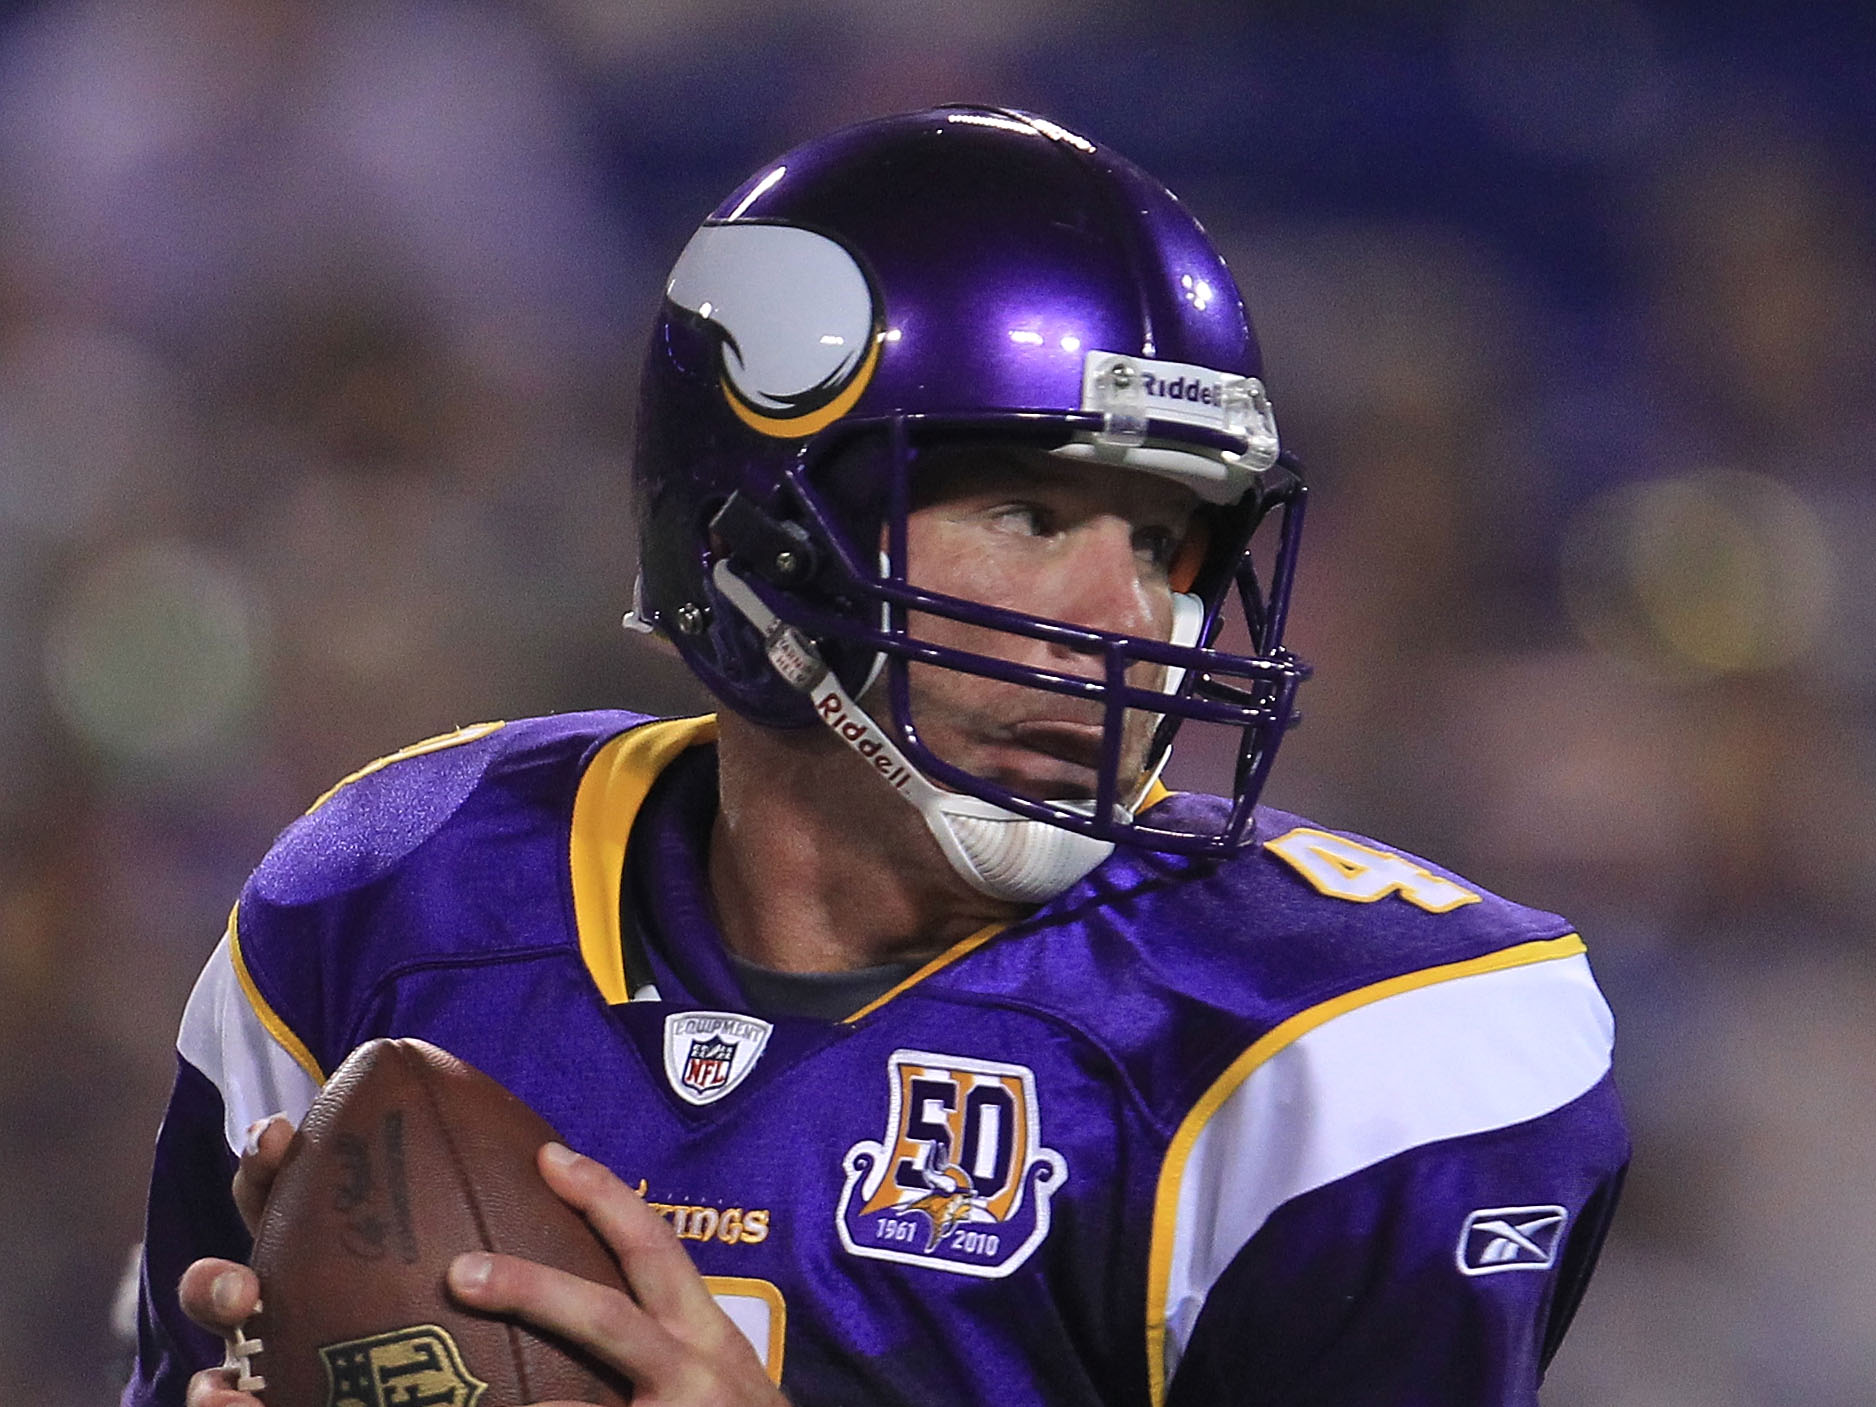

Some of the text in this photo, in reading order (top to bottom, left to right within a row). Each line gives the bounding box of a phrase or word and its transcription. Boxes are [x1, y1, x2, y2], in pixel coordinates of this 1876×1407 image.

[818, 693, 911, 788] Riddell
[1263, 828, 1482, 914] 4
[674, 1019, 761, 1042] EQUIPMENT
[685, 1058, 726, 1087] NFL
[895, 1078, 1016, 1198] 50
[877, 1218, 1000, 1256] 1961 2010
